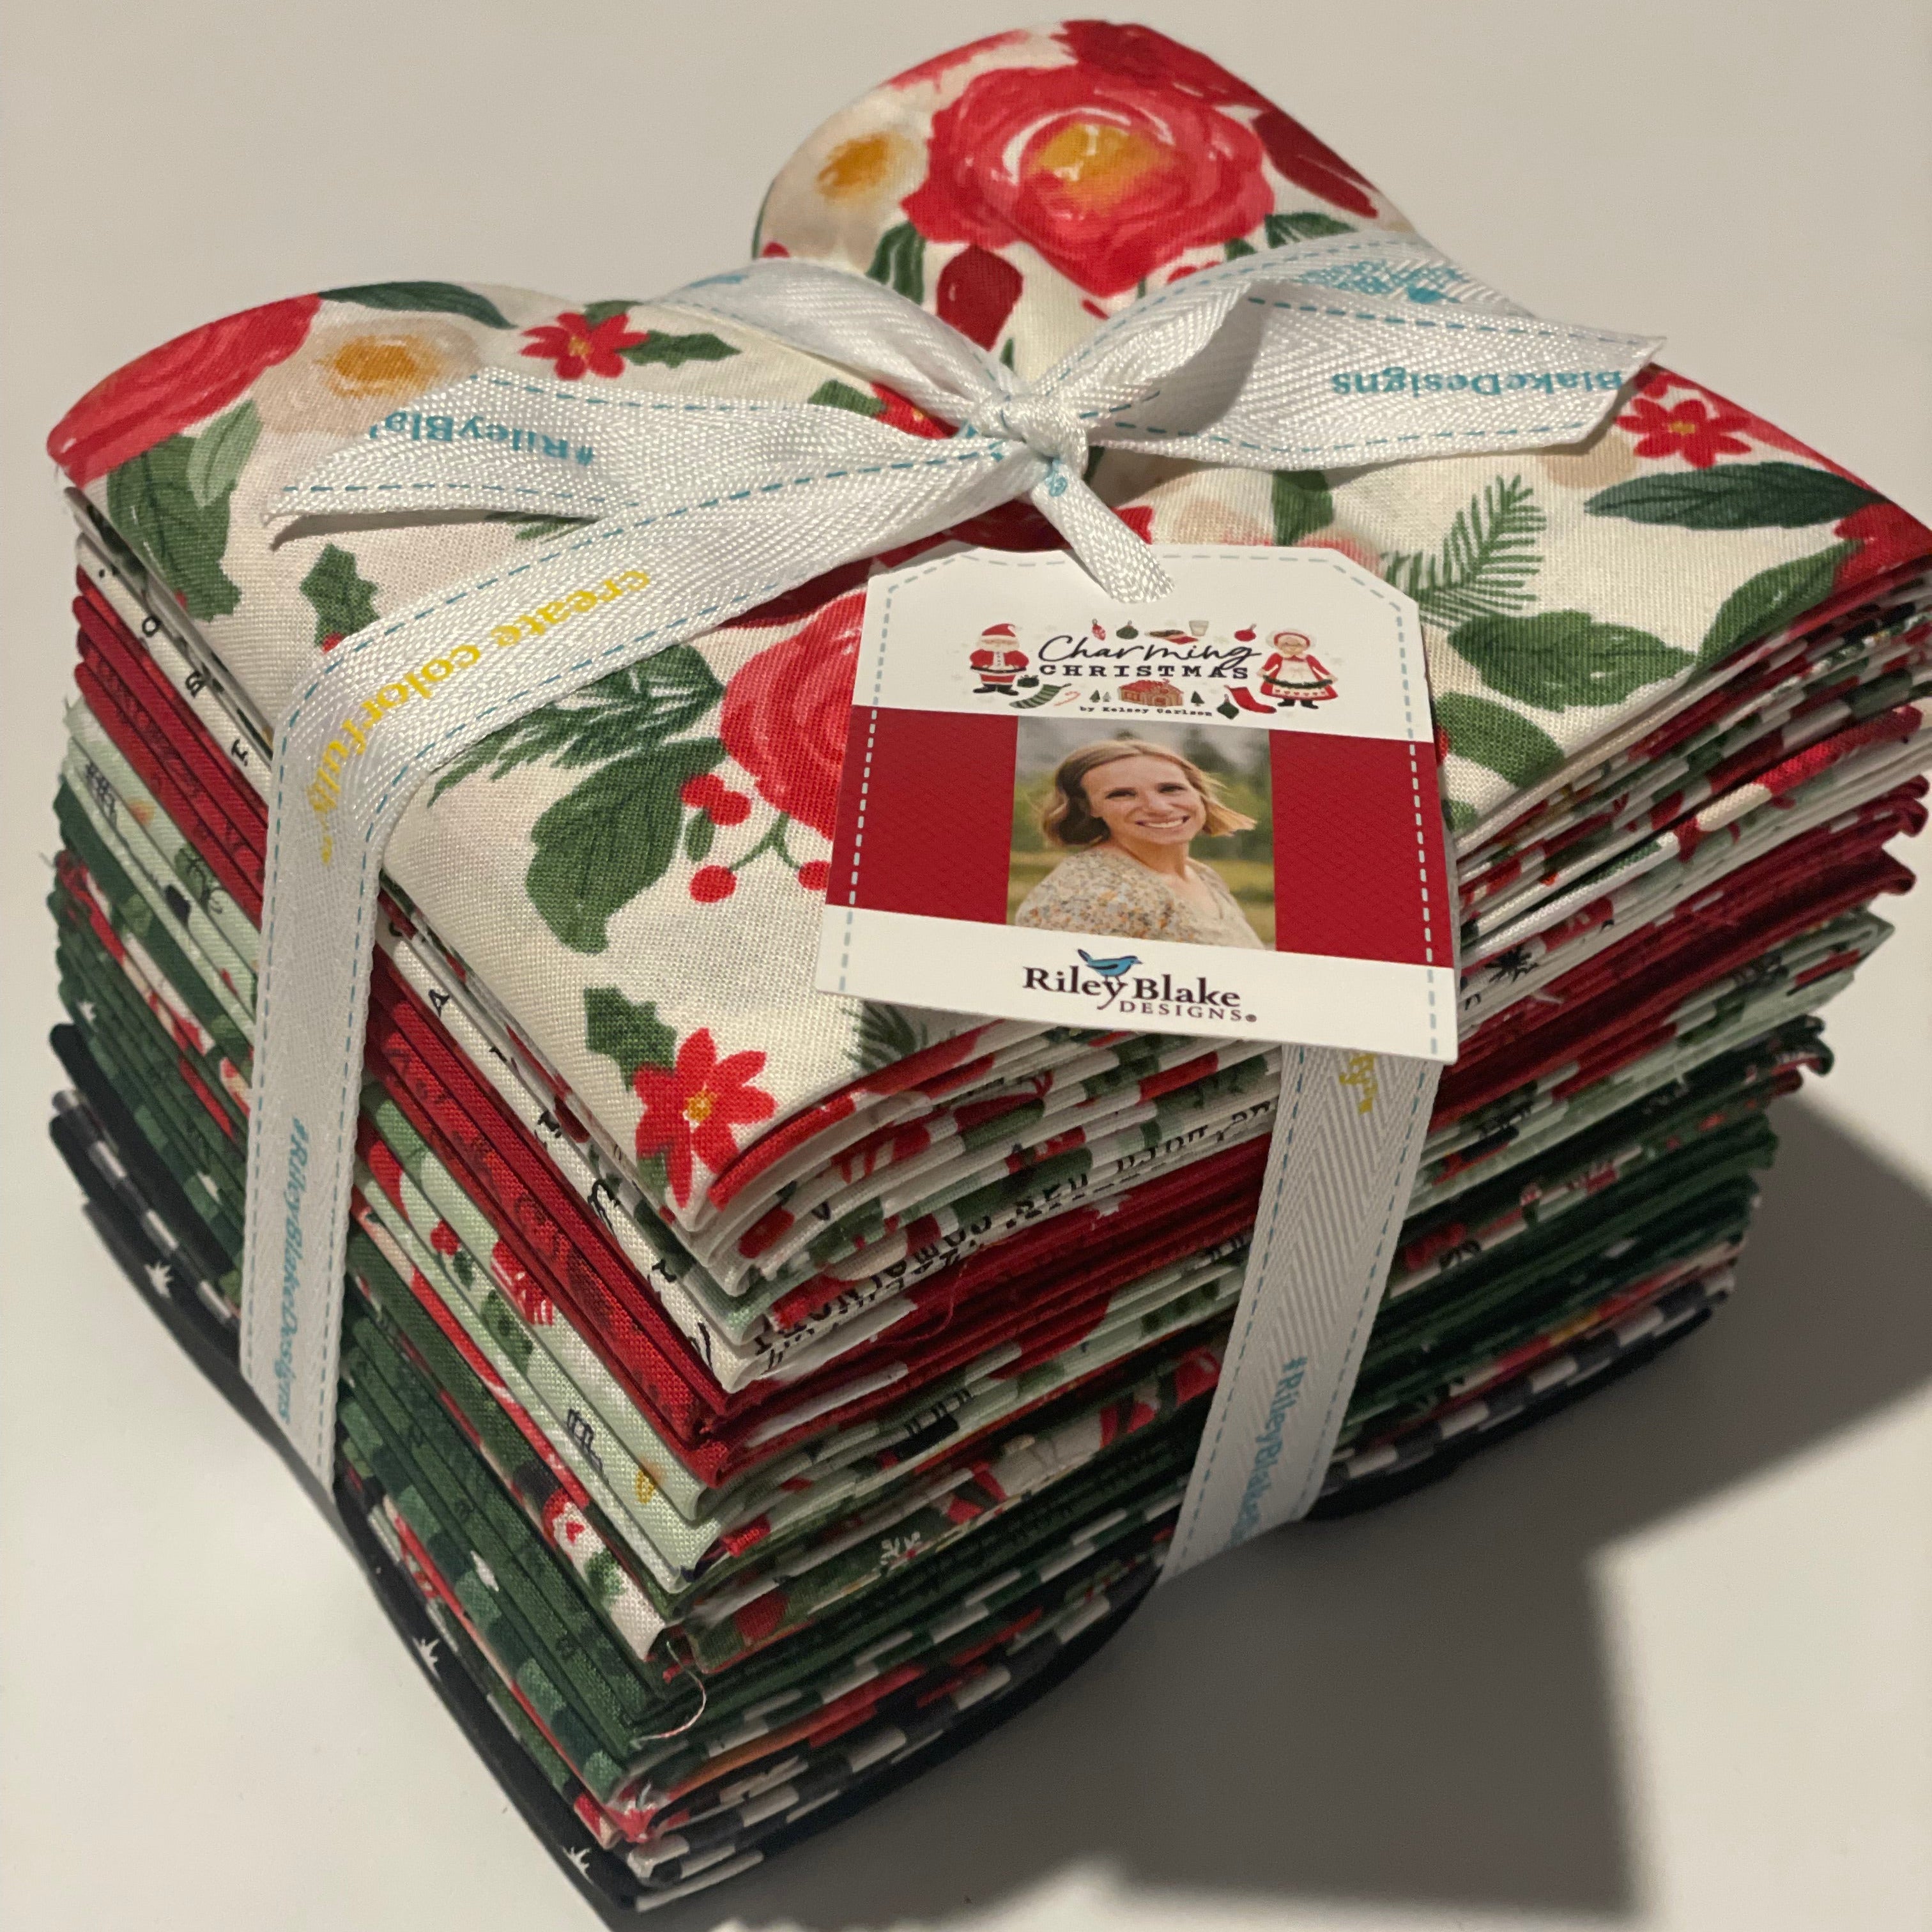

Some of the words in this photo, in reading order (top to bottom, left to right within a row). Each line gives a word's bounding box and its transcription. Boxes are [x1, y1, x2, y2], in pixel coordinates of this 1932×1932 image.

[490, 570, 650, 647] create
[1038, 635, 1262, 670] Charming
[1039, 664, 1249, 679] CHRISTMAS
[1023, 965, 1128, 1010] Riley
[1133, 974, 1241, 1008] Blake
